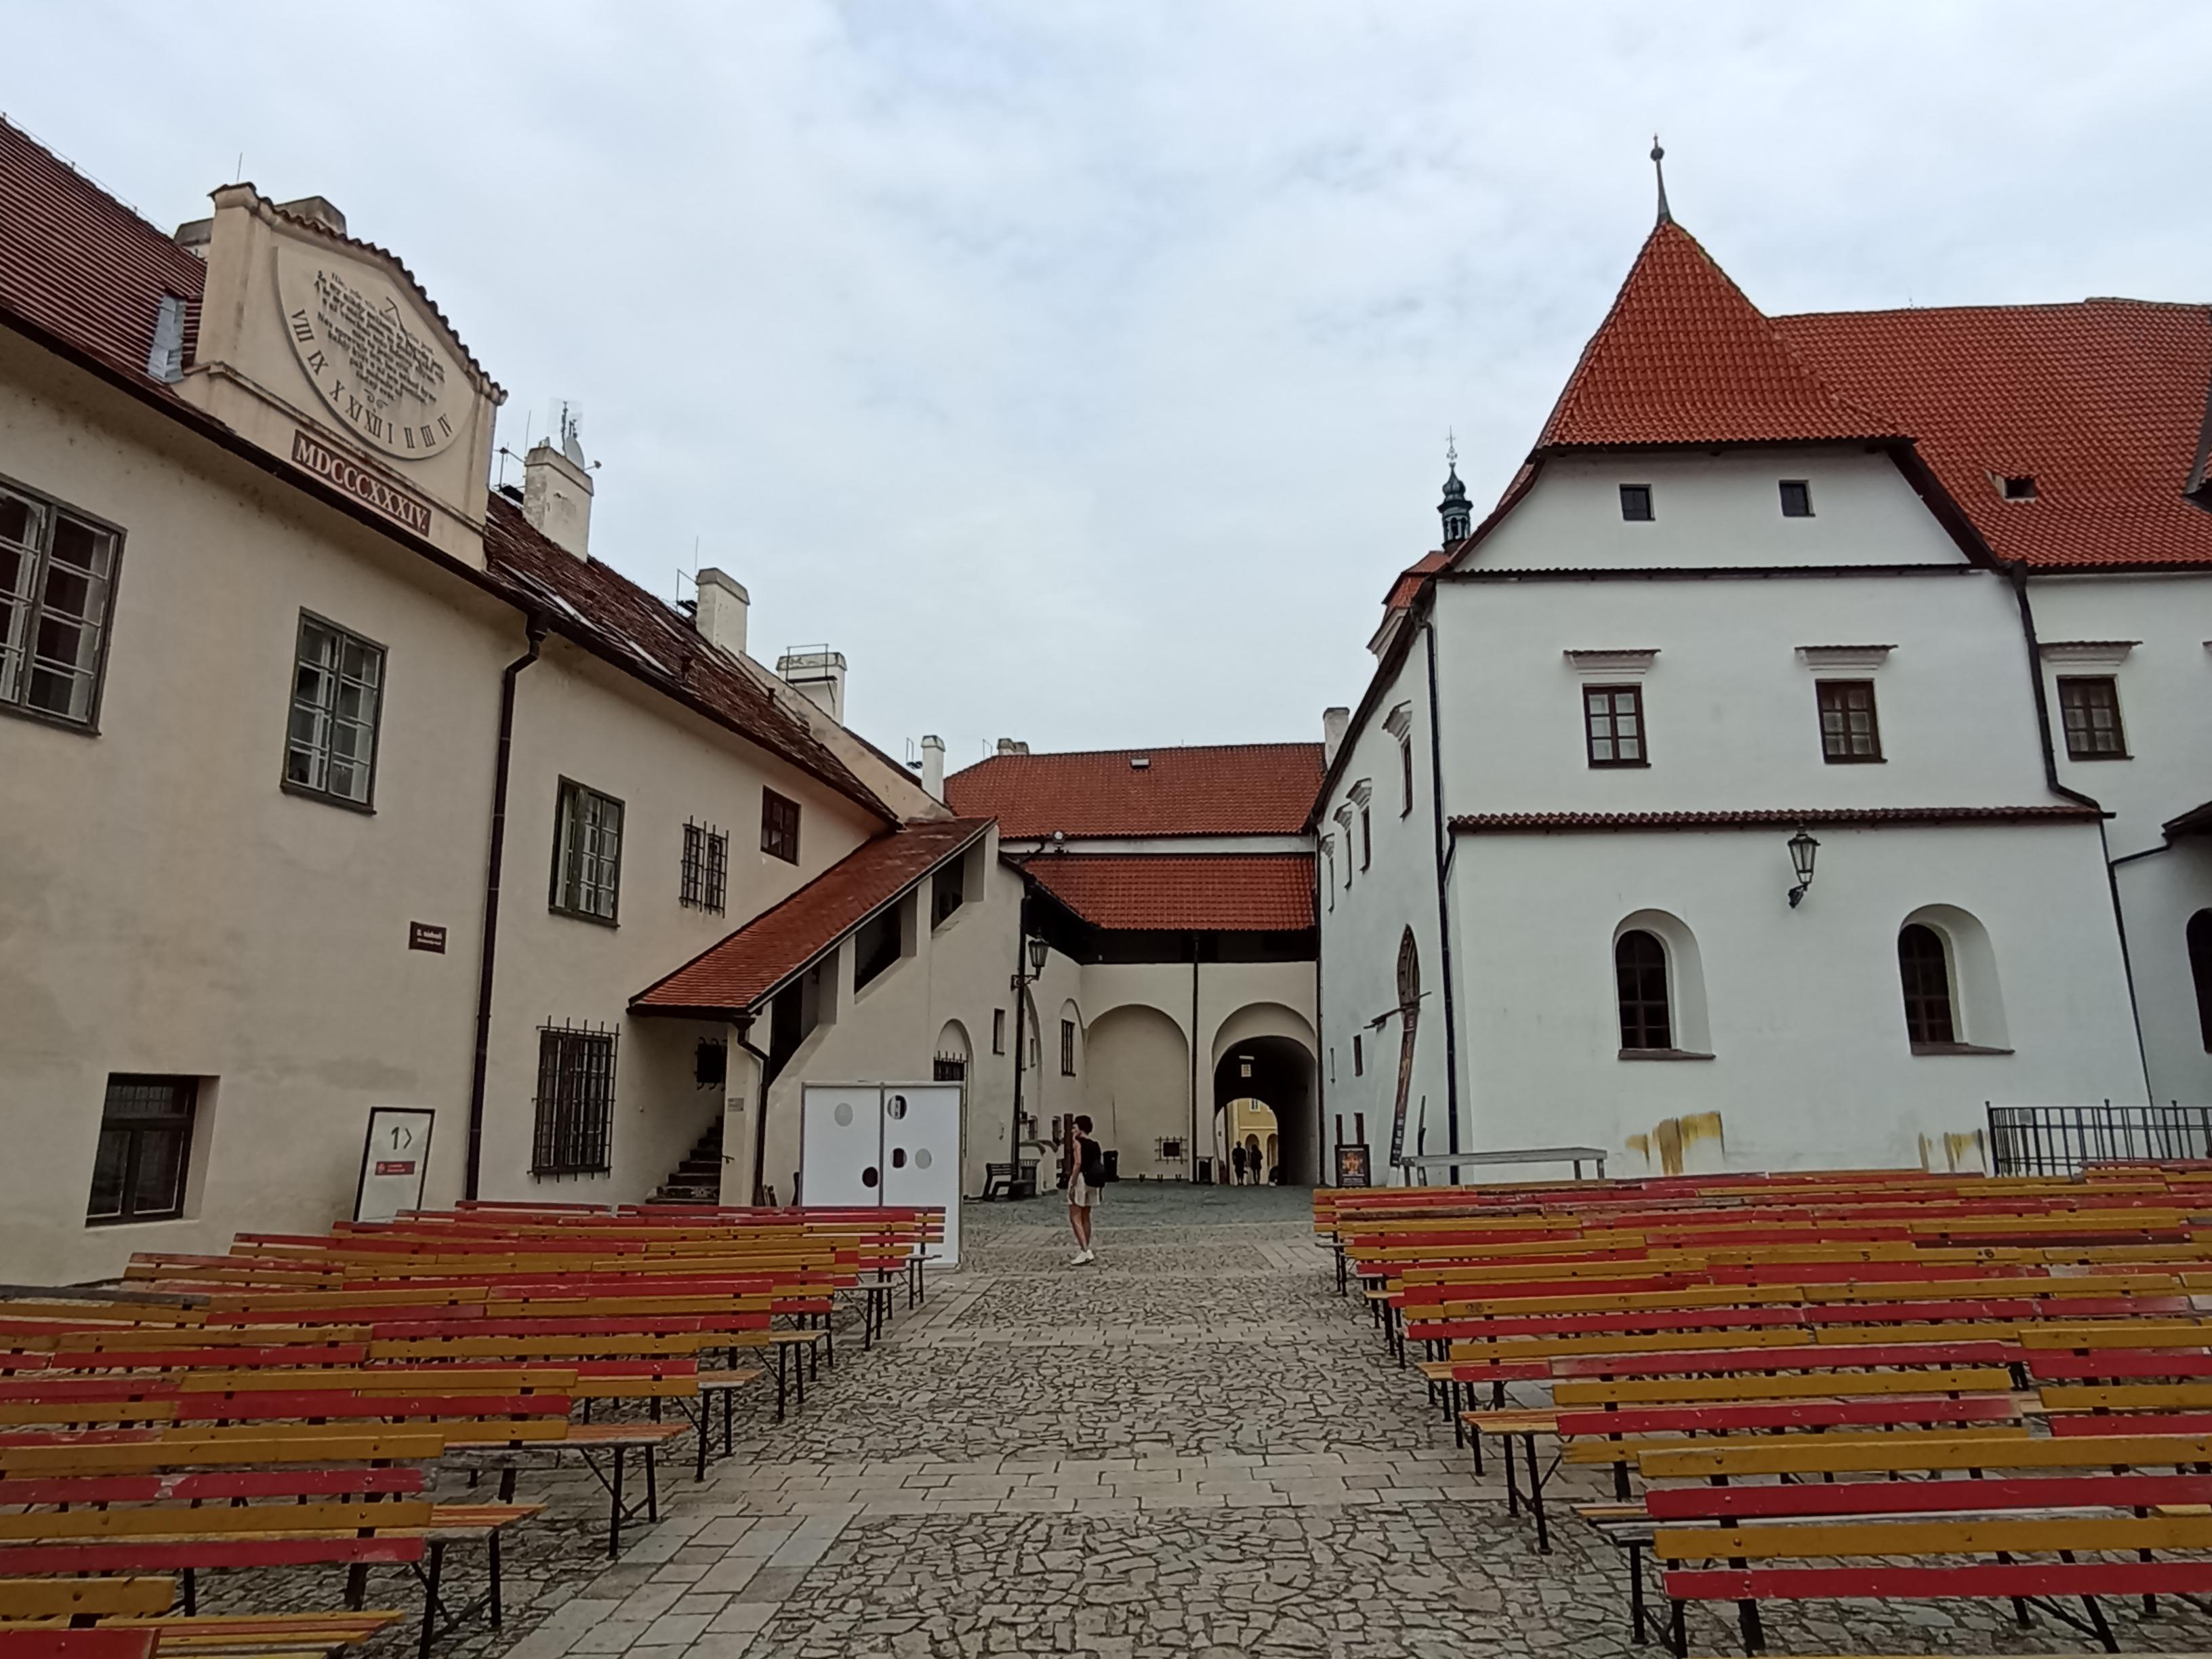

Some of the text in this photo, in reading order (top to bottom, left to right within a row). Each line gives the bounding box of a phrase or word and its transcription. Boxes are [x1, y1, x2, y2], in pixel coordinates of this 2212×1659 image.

[291, 309, 314, 342] VIII
[308, 350, 329, 375] IX
[329, 380, 345, 402] X
[345, 394, 363, 422] XI
[364, 409, 382, 438] XII
[388, 422, 393, 444] I
[437, 413, 452, 437] IV
[404, 427, 415, 449] II
[420, 425, 436, 447] III
[296, 439, 427, 532] MDCCCXXXIV.
[1861, 1251, 1870, 1261] 5
